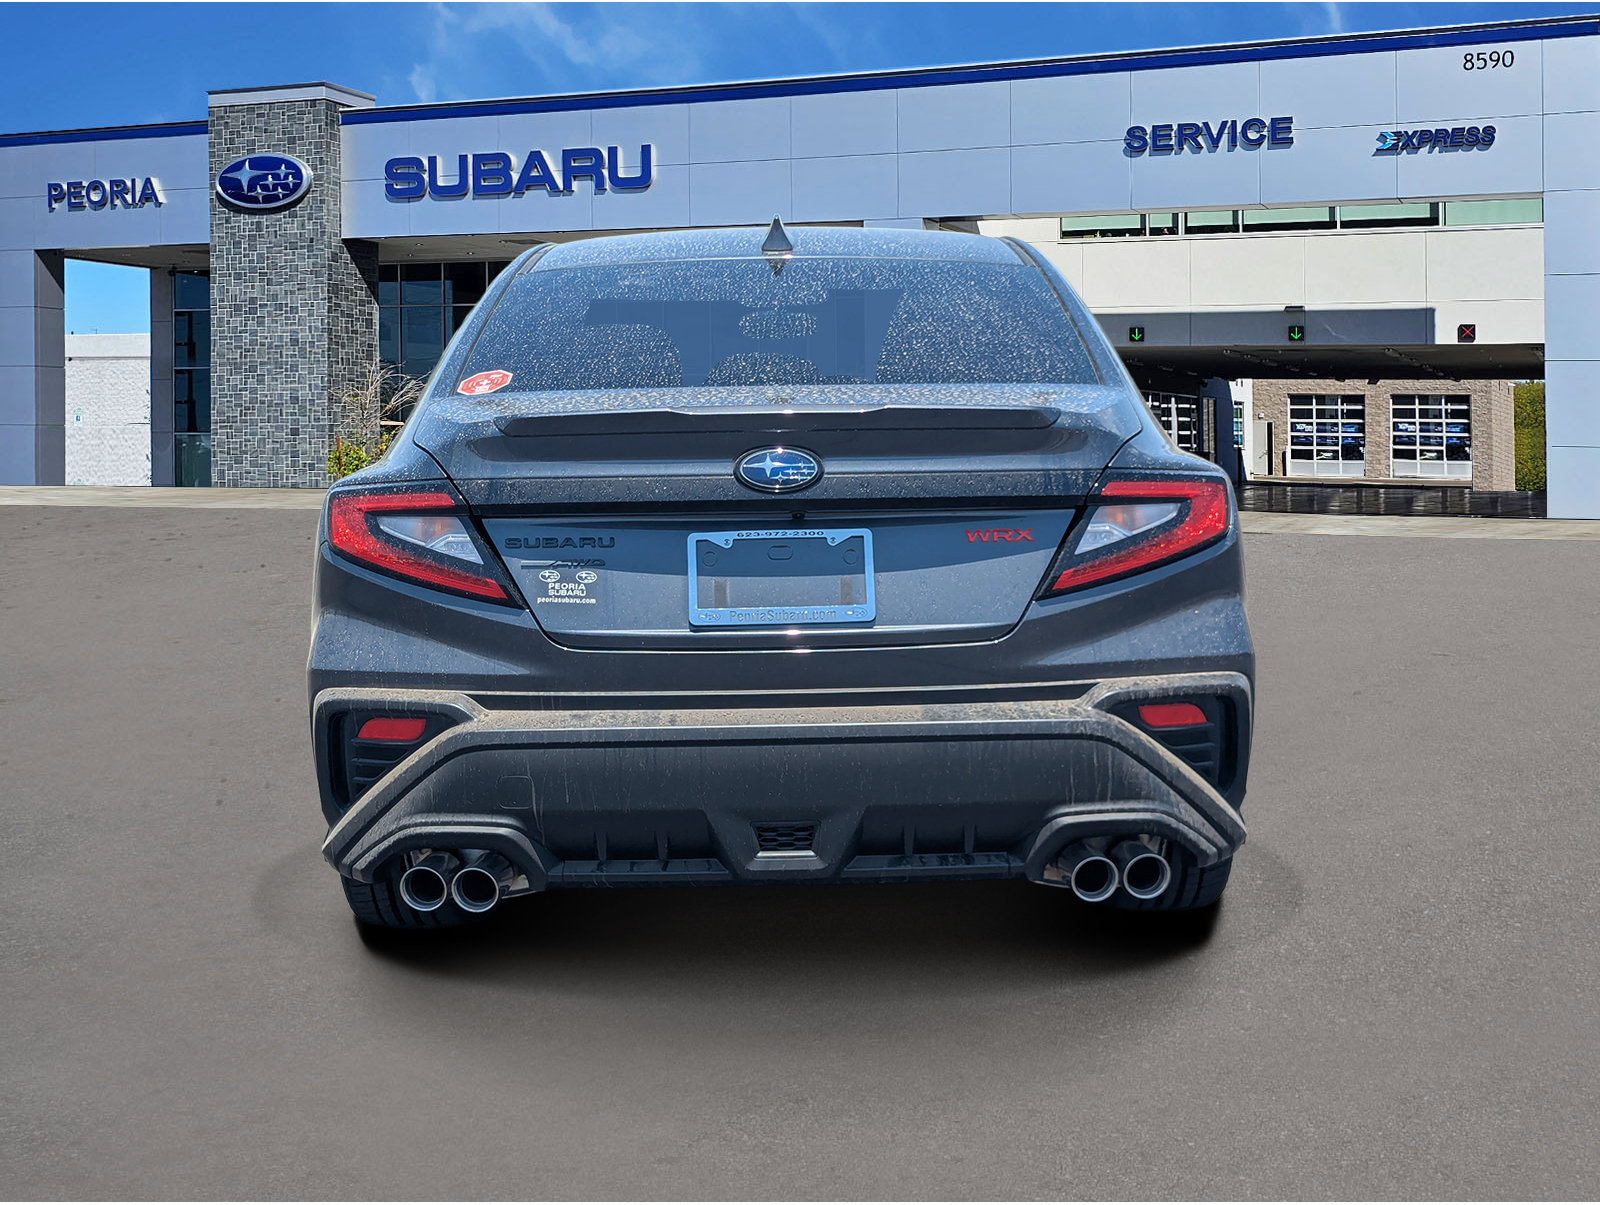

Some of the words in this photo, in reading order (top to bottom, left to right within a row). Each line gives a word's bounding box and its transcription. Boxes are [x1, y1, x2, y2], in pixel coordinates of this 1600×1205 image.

[1463, 50, 1515, 71] 8590
[1125, 117, 1294, 153] SERVICE
[1376, 125, 1496, 152] EXPRESS
[385, 144, 653, 200] SUBARU
[48, 177, 161, 210] PEORIA
[504, 537, 615, 549] SUBARU
[736, 530, 825, 539] 623-972-2300
[965, 528, 1034, 543] WRX
[537, 596, 597, 604] peoriasubaru.com
